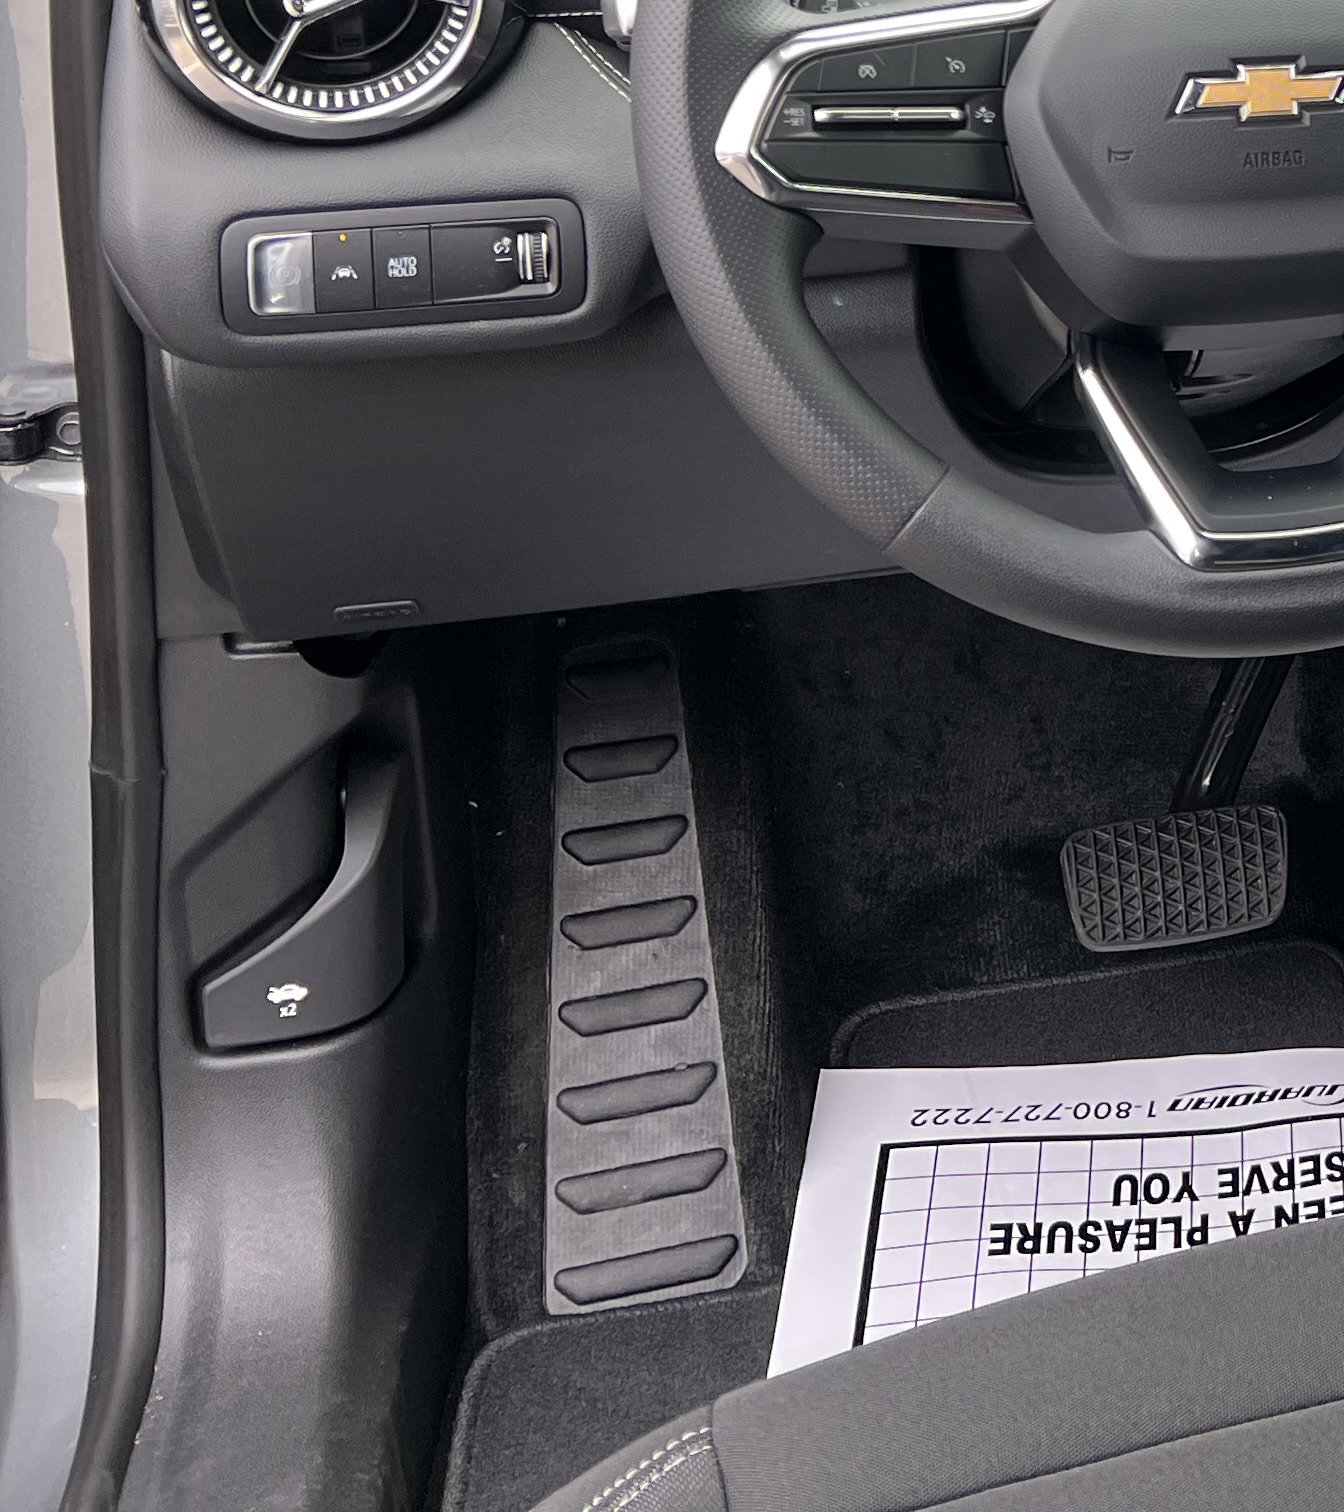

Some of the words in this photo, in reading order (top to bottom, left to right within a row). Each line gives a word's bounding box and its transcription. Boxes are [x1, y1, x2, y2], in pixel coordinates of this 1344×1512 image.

[1242, 149, 1306, 170] AIRBAG
[389, 257, 417, 267] AUTO
[910, 1099, 1157, 1127] 1-800-727-7222
[1111, 1170, 1200, 1207] YOU
[987, 1212, 1210, 1257] PLEASURE
[1227, 1207, 1255, 1237] A
